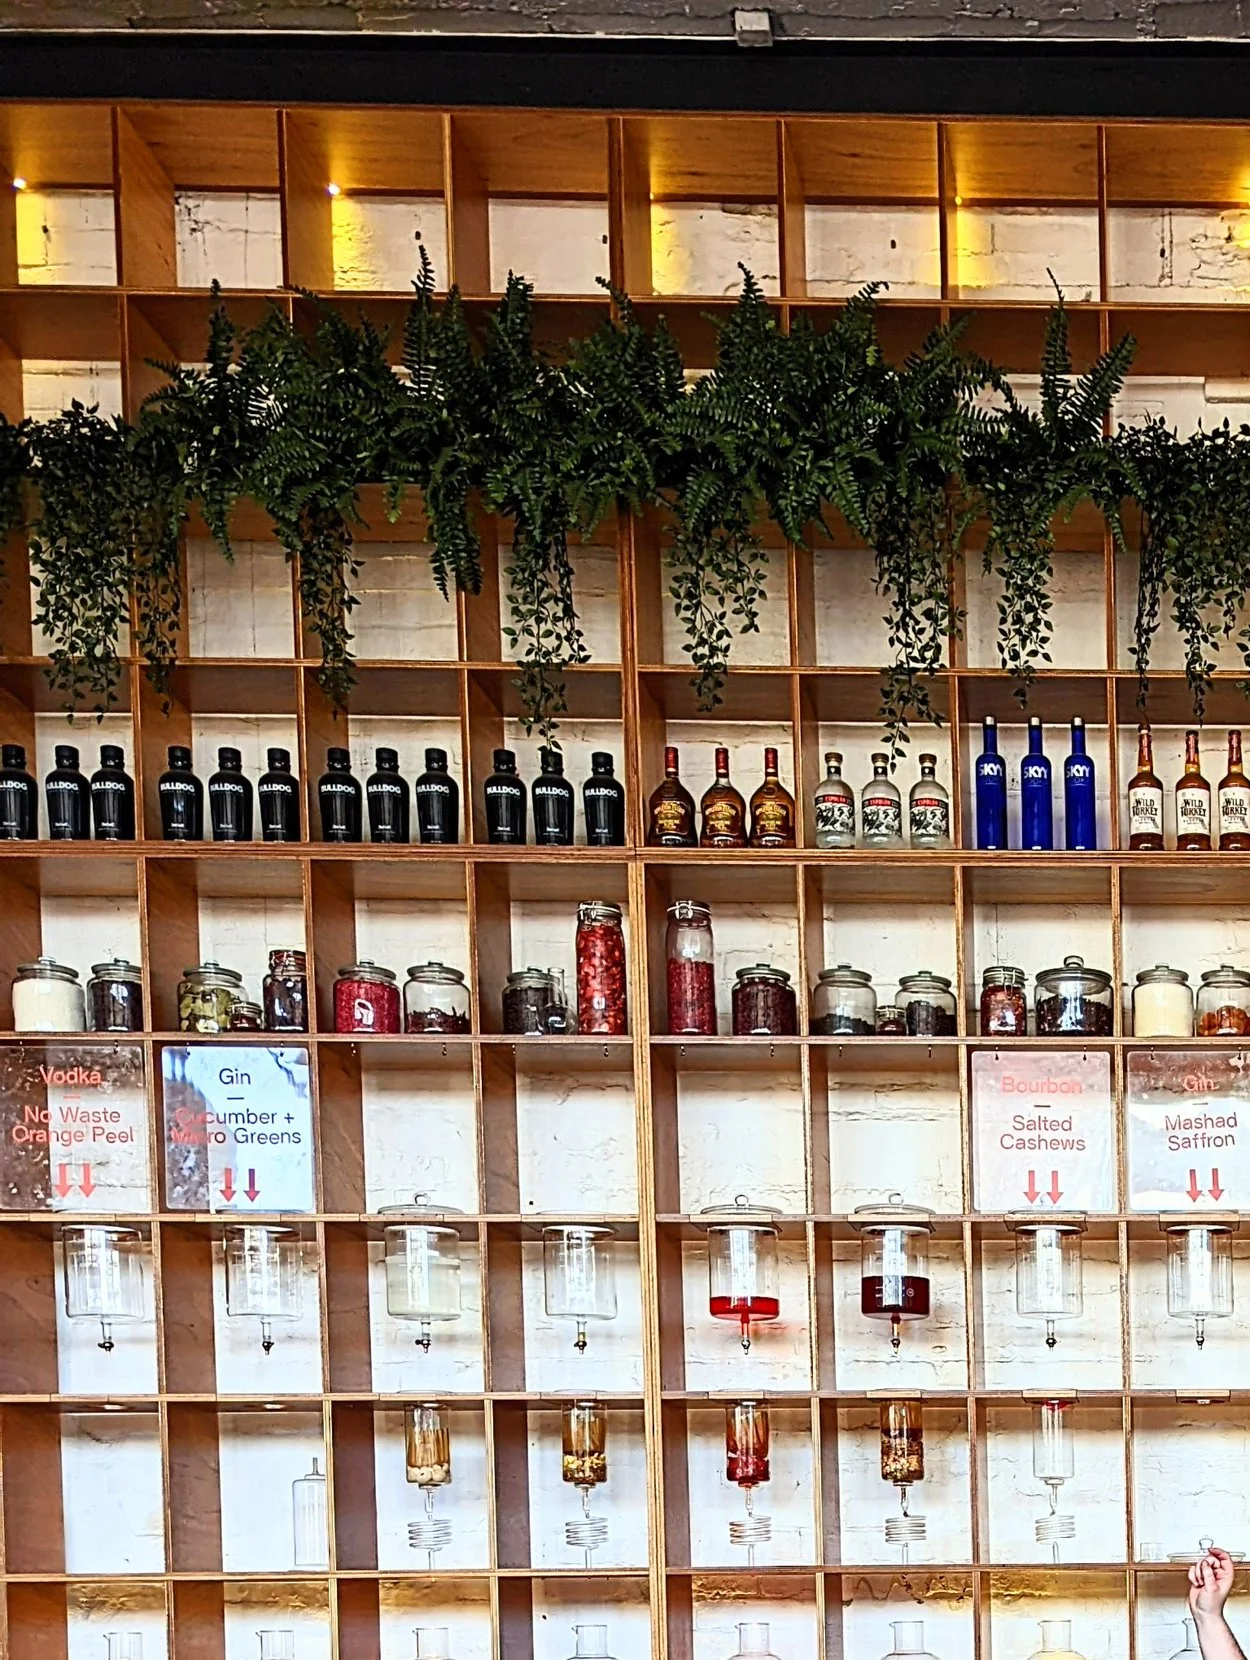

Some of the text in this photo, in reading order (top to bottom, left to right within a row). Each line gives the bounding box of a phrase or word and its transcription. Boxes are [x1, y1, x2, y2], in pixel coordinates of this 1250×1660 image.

[979, 763, 1003, 776] SKYY
[1024, 766, 1048, 780] SKYY
[1066, 764, 1090, 778] SKYY
[46, 781, 78, 790] BULLDOG
[92, 781, 126, 791] BULLDOG
[160, 782, 195, 792] BULLDOG
[210, 782, 244, 792] BULLDOG
[259, 782, 292, 792] BULLDOG
[320, 784, 356, 794] BULLDOG
[368, 784, 401, 794] BULLDOG
[416, 784, 450, 794] BULLDOG
[486, 786, 520, 796] BULLDOG
[535, 787, 569, 798] BULLDOG
[585, 788, 618, 798] BULLDOG
[1135, 798, 1155, 807] WILD
[1184, 798, 1204, 808] WILD
[1224, 798, 1244, 807] WILD
[40, 1066, 102, 1085] Vodka
[219, 1068, 252, 1086] Gin
[1002, 1076, 1082, 1094] Bourbon
[1183, 1074, 1216, 1092] Gin
[24, 1106, 121, 1123] No Waste
[284, 1113, 294, 1124] +
[1012, 1115, 1072, 1132] Salted
[1164, 1112, 1238, 1132] Mashad
[12, 1126, 134, 1147] Orange Peel
[170, 1128, 302, 1144] Mro Greens
[1000, 1134, 1086, 1150] Cashews
[1168, 1133, 1236, 1152] Saffron
